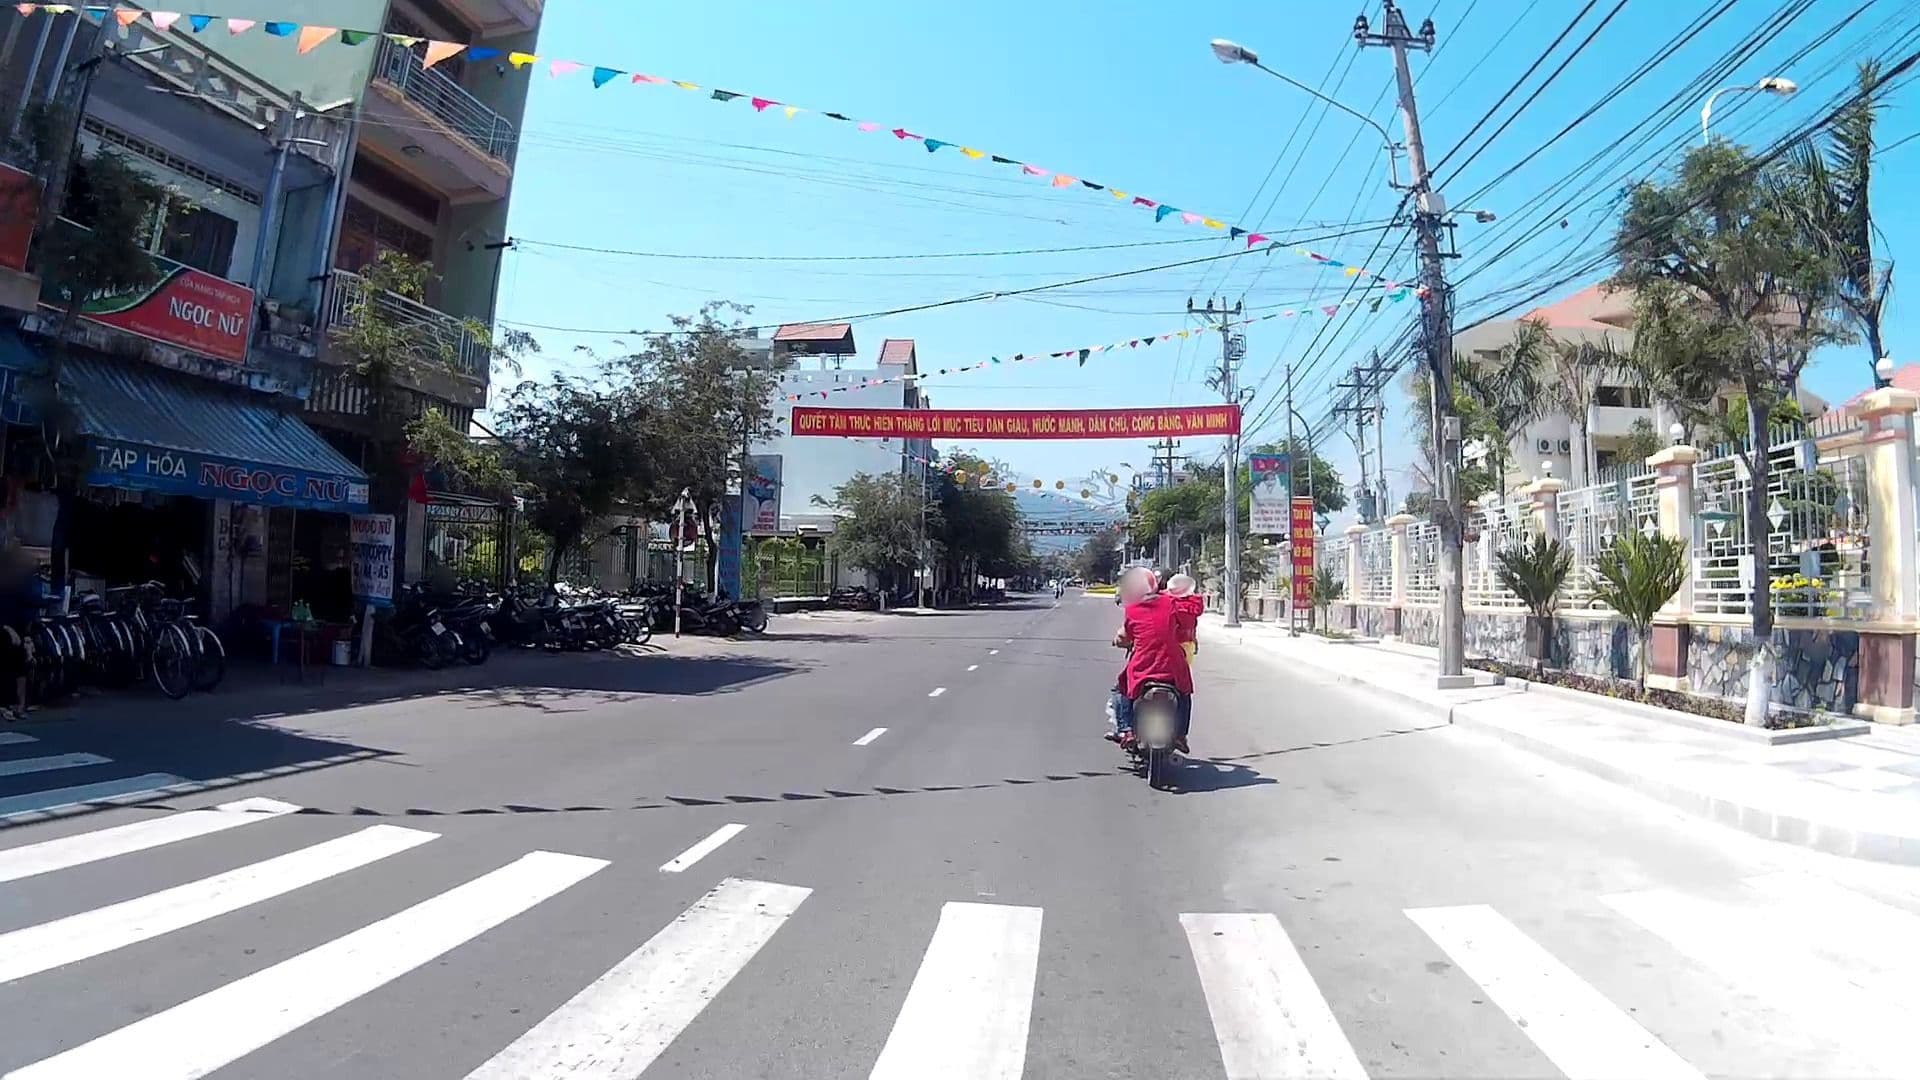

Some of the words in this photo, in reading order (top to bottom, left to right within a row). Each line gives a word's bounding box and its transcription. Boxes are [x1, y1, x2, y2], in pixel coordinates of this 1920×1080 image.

[169, 296, 214, 329] NGỌC
[218, 312, 244, 336] NỮ
[1033, 415, 1056, 433] NƯỚC
[1089, 414, 1106, 432] DÂN
[1132, 415, 1155, 432] CÔNG
[1186, 412, 1204, 430] VĂN
[1206, 414, 1227, 429] MINH
[146, 451, 187, 478] HÓA
[198, 462, 297, 499] NGỌC
[303, 475, 350, 502] NỮ
